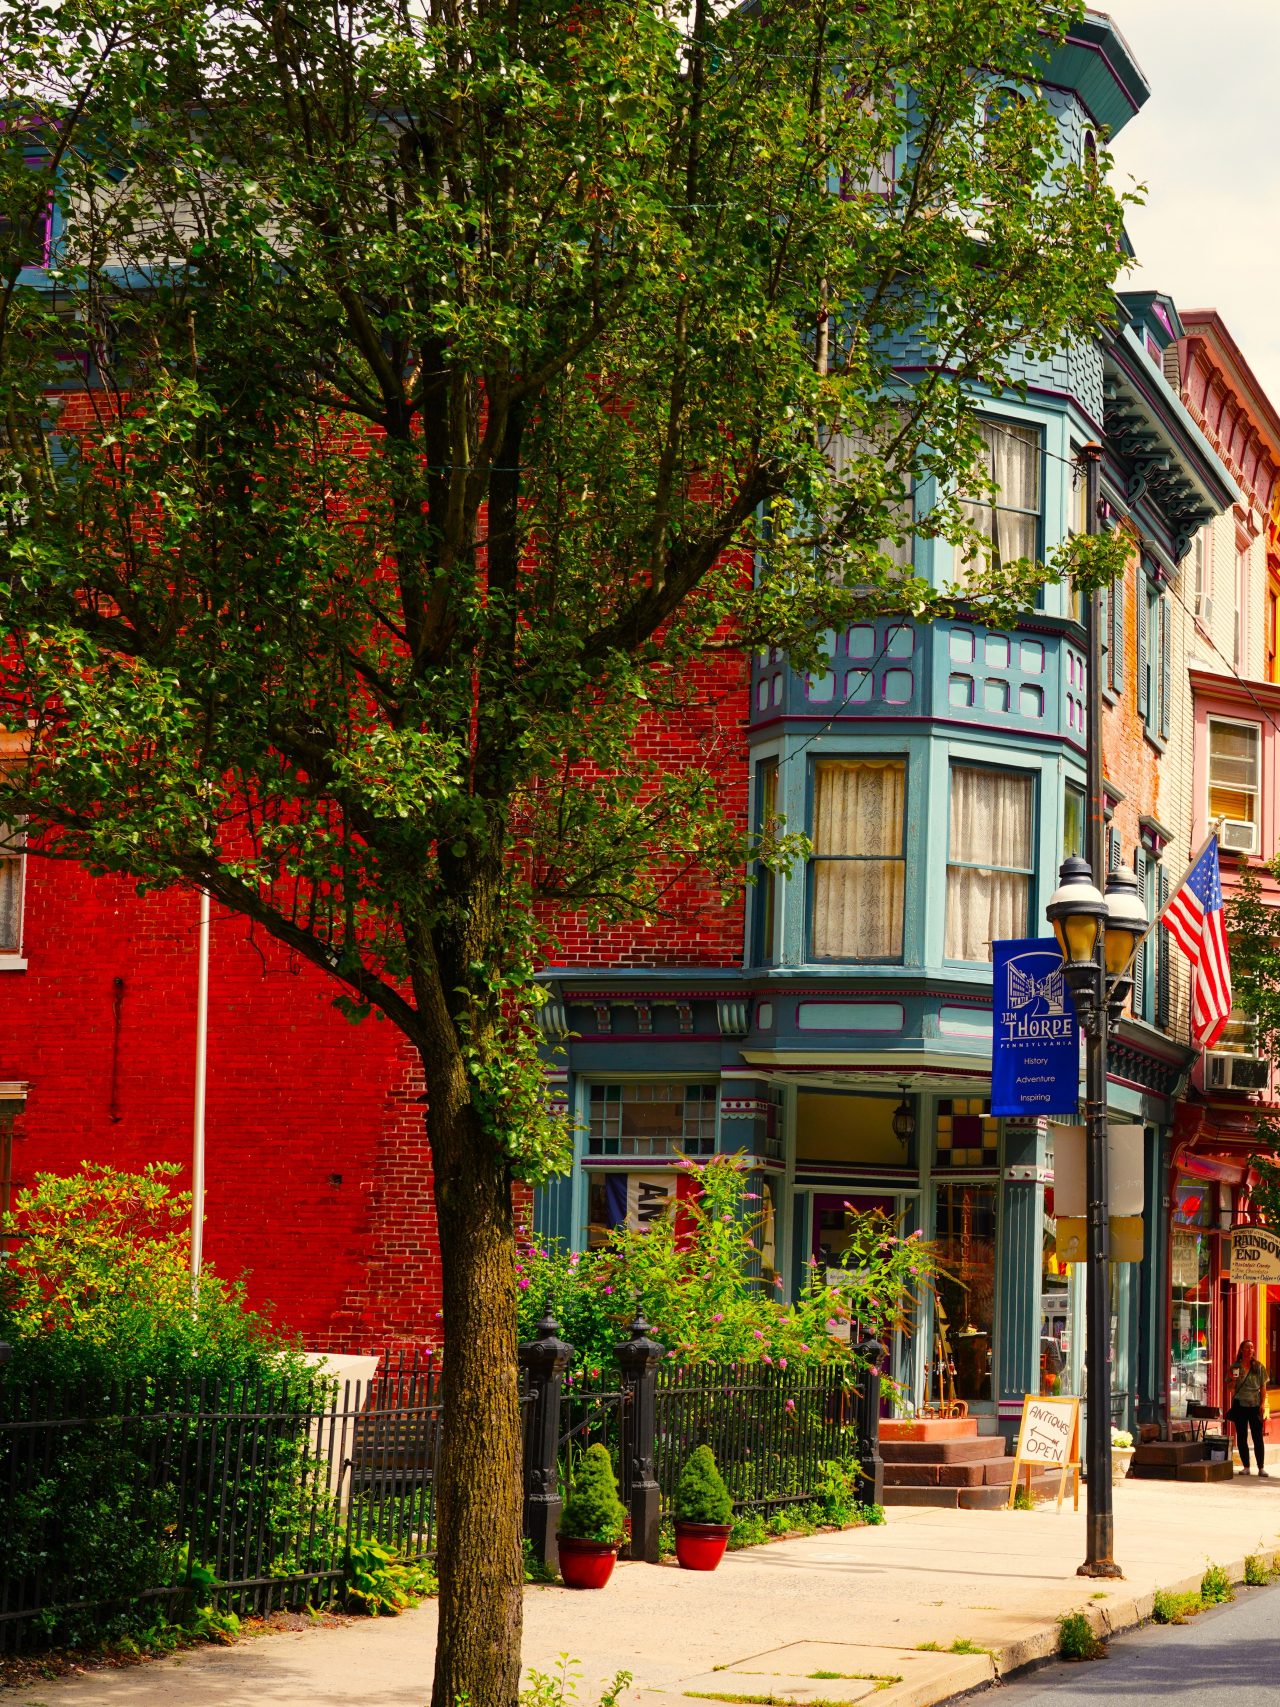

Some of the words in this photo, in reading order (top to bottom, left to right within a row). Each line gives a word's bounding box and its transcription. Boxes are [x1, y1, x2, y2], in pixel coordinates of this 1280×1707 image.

[1001, 1012, 1017, 1023] JIM
[1004, 1012, 1072, 1041] THORPE
[1024, 1056, 1048, 1066] History
[1016, 1075, 1056, 1083] Adventure
[1020, 1093, 1051, 1102] Inspiring
[1236, 1249, 1260, 1260] END
[1029, 1406, 1070, 1436] ANTIQUES
[1026, 1438, 1063, 1461] OPEN
